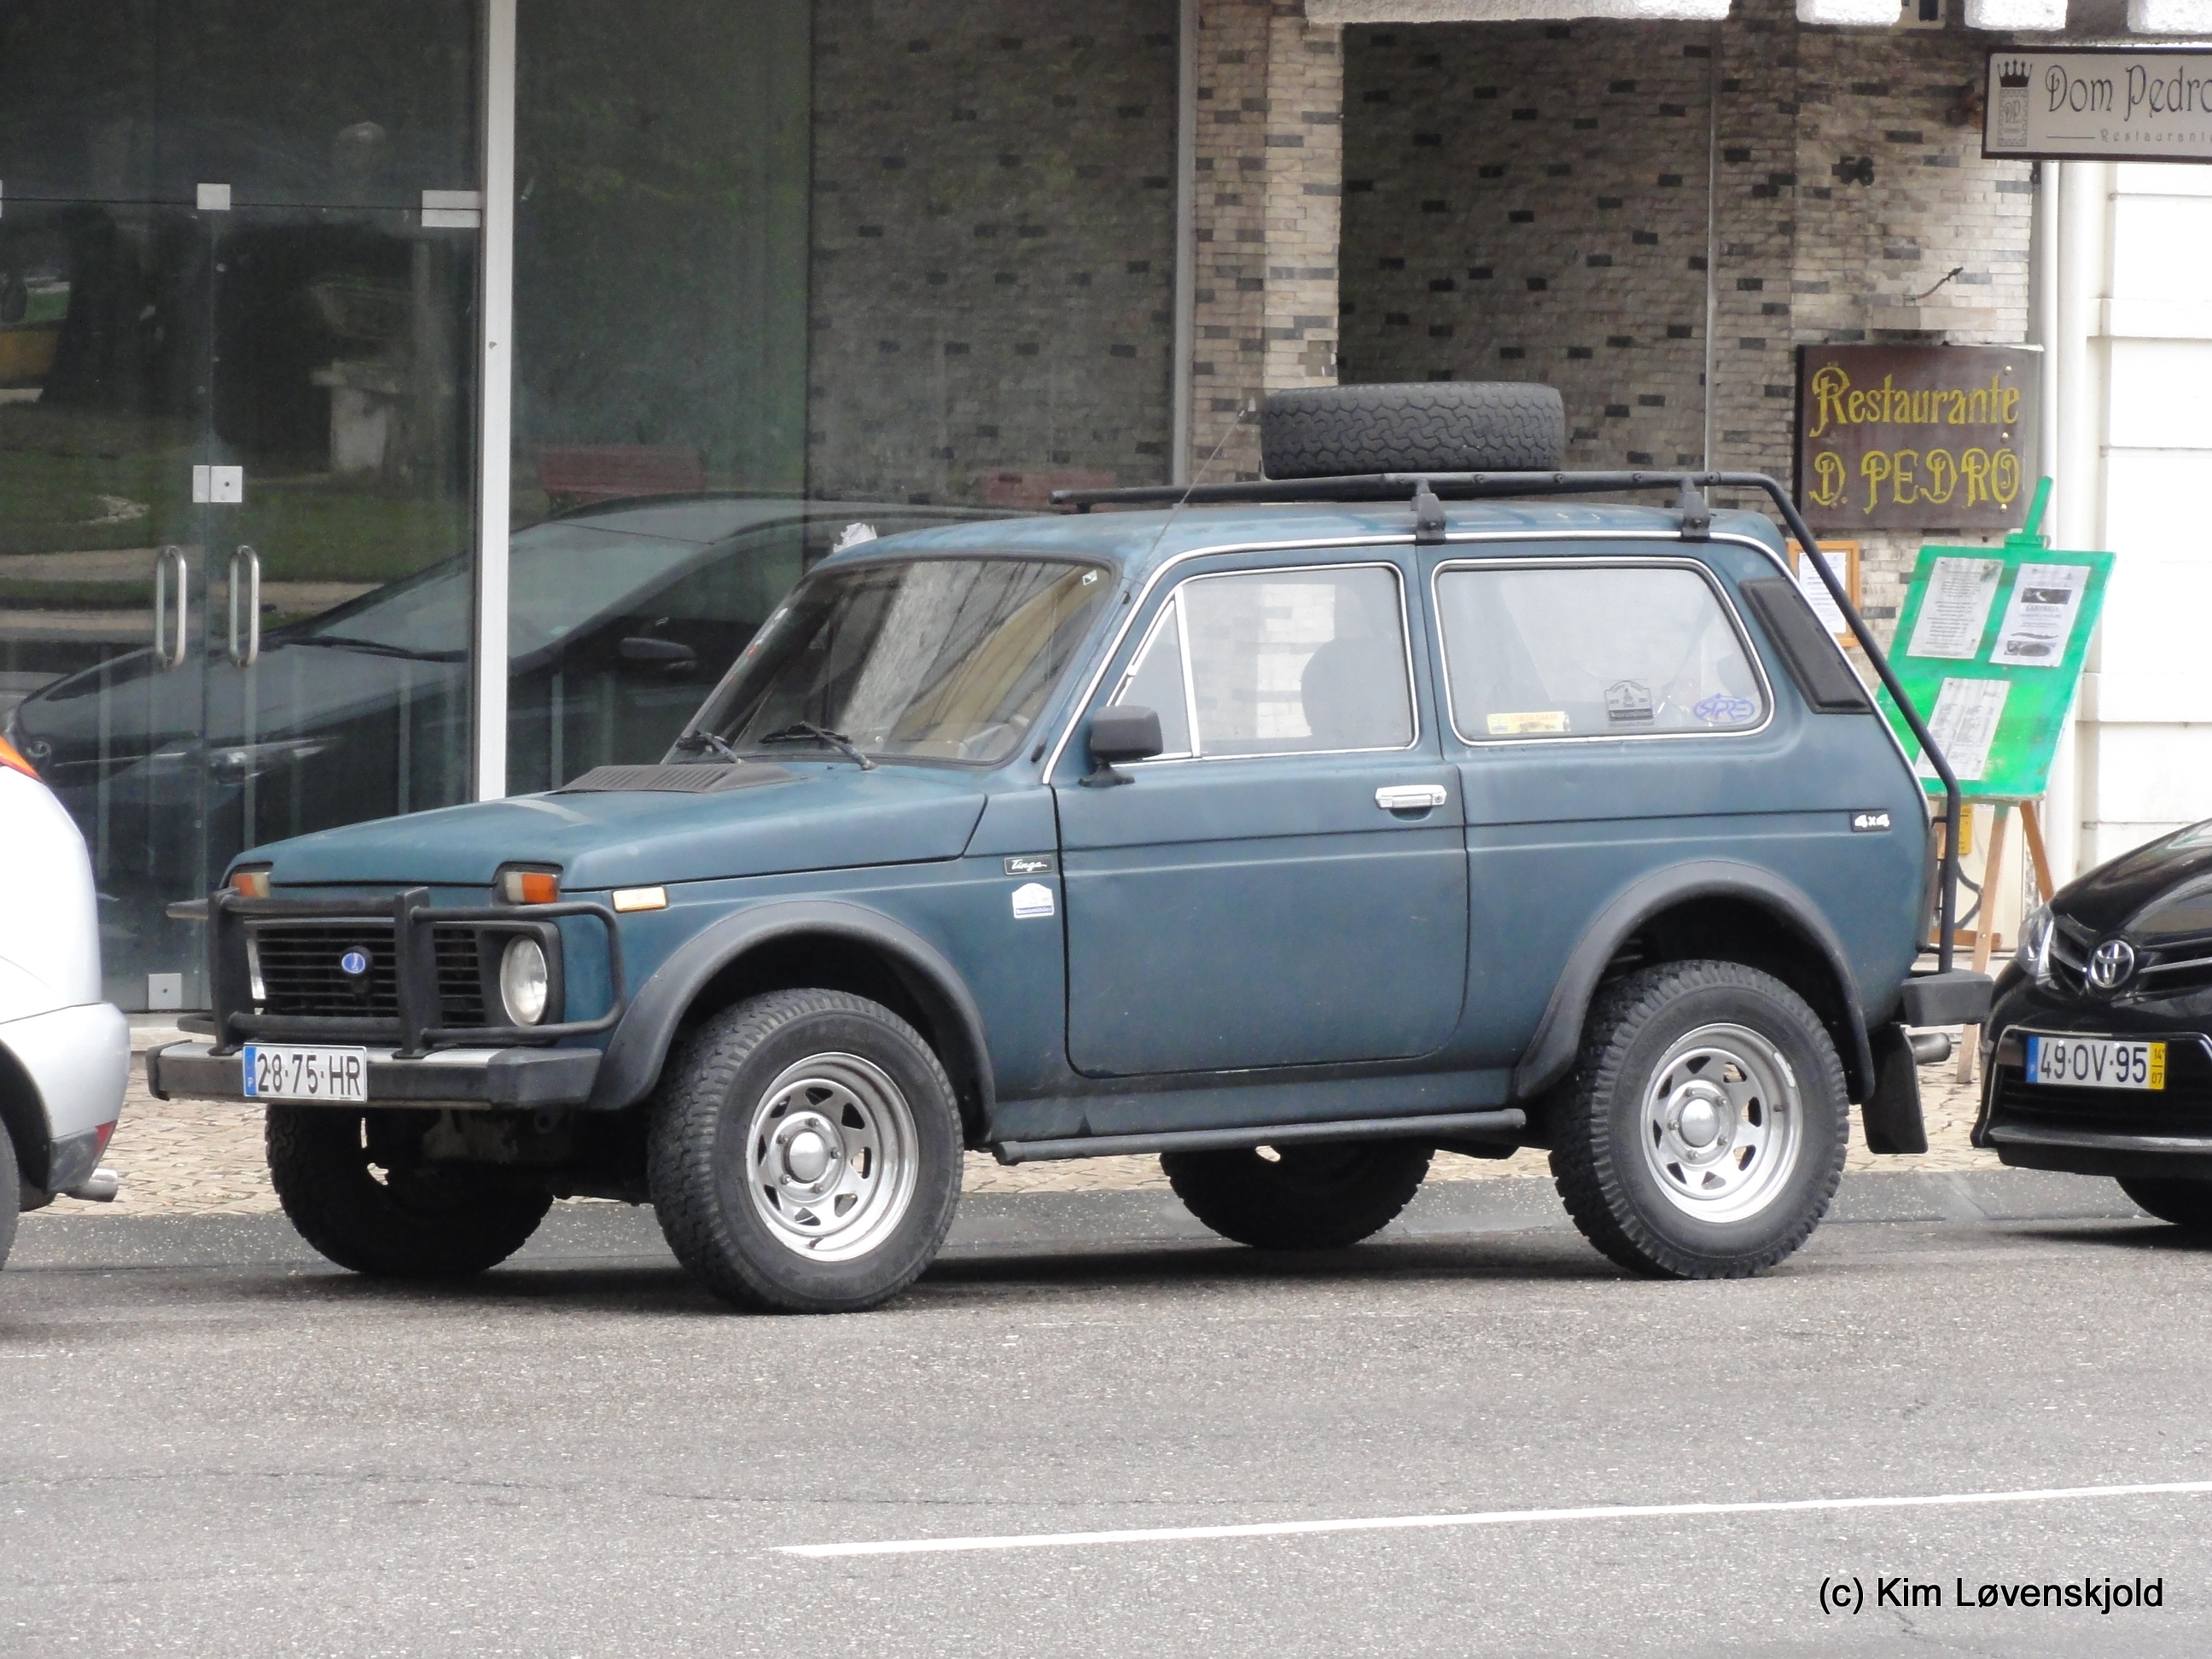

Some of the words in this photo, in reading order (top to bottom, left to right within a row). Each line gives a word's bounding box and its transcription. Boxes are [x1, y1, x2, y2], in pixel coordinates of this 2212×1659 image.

[2045, 64, 2114, 113] Dom
[2123, 64, 2212, 122] Pedro
[2100, 129, 2212, 143] Restaurant
[1808, 365, 2021, 438] Restaurante
[1808, 451, 1848, 506] D.
[1860, 447, 2021, 515] PEDRO
[1854, 813, 1890, 828] 4x4
[2151, 1072, 2163, 1085] 07
